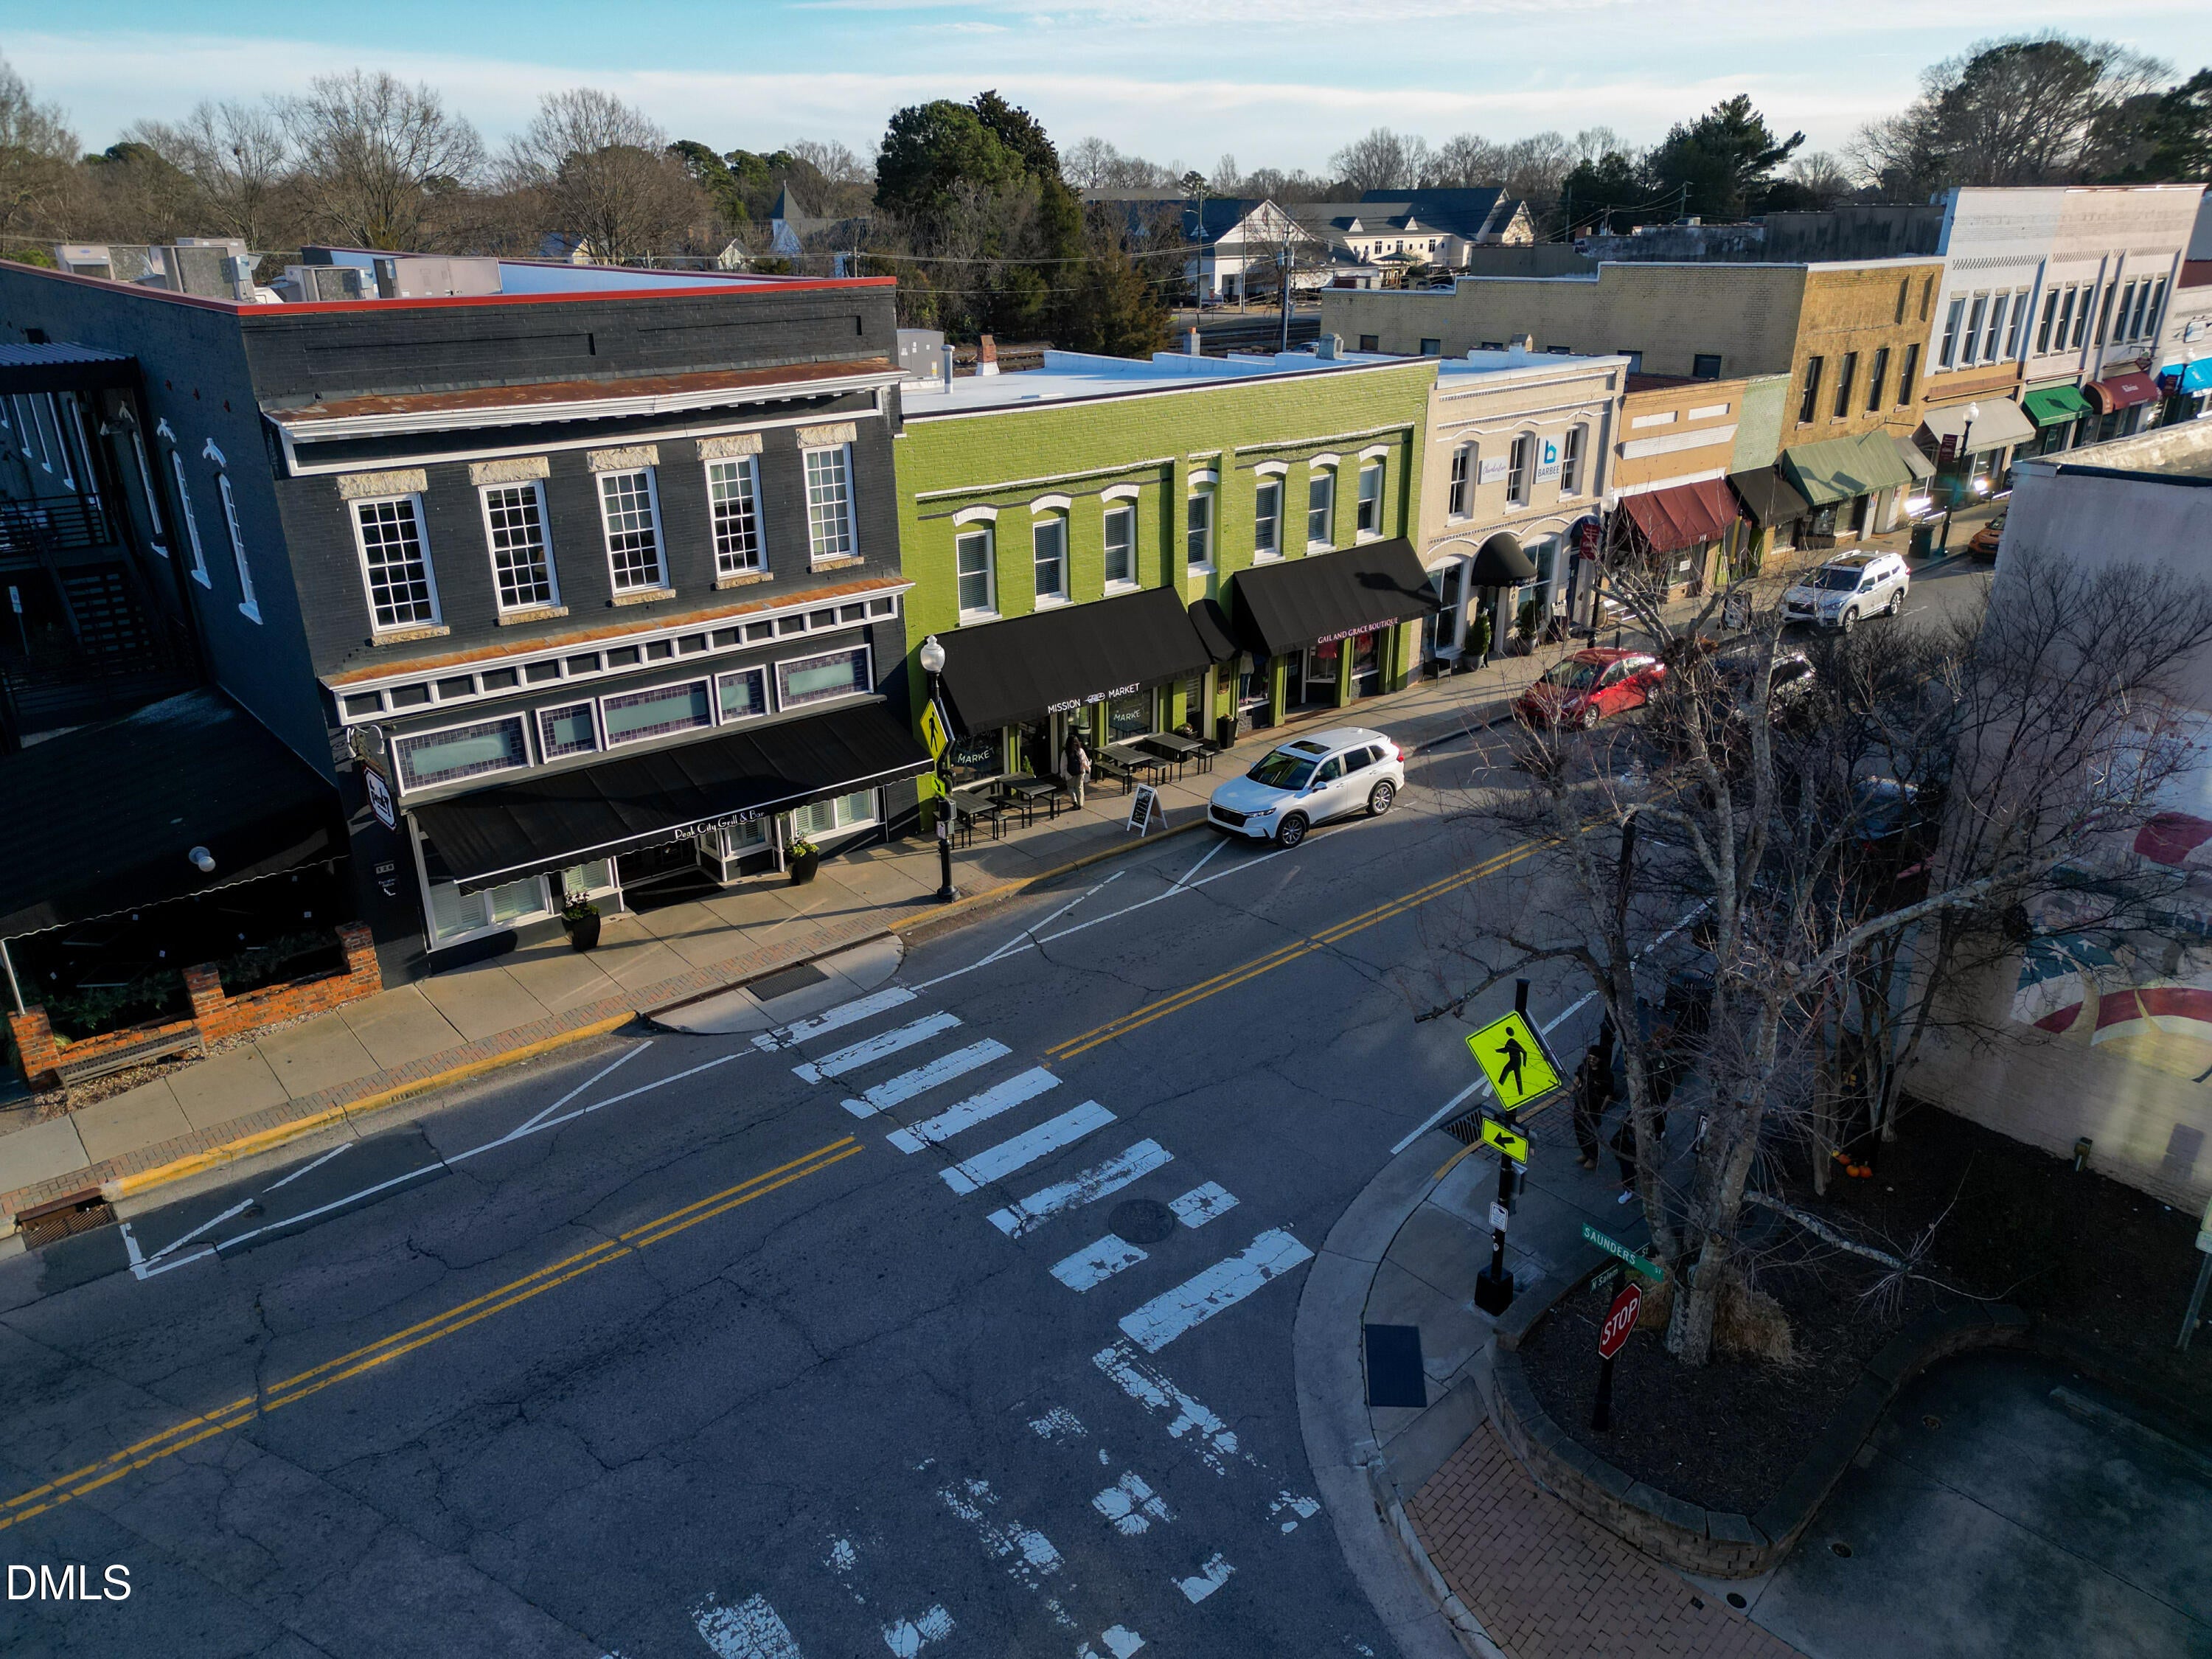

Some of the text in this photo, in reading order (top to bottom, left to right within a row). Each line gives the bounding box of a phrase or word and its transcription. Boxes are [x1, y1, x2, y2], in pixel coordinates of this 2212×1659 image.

[1537, 465, 1560, 477] BARBEE
[1318, 616, 1399, 644] GAIL AND GRACE BOUTIQUE
[1048, 683, 1141, 714] MISSION MARKET
[957, 747, 995, 764] MARKET
[675, 810, 765, 840] Peak City Grill & Bar
[1583, 1227, 1636, 1265] SAUNDERS
[1593, 1245, 1649, 1291] N Salem St
[1601, 1297, 1638, 1346] STOP
